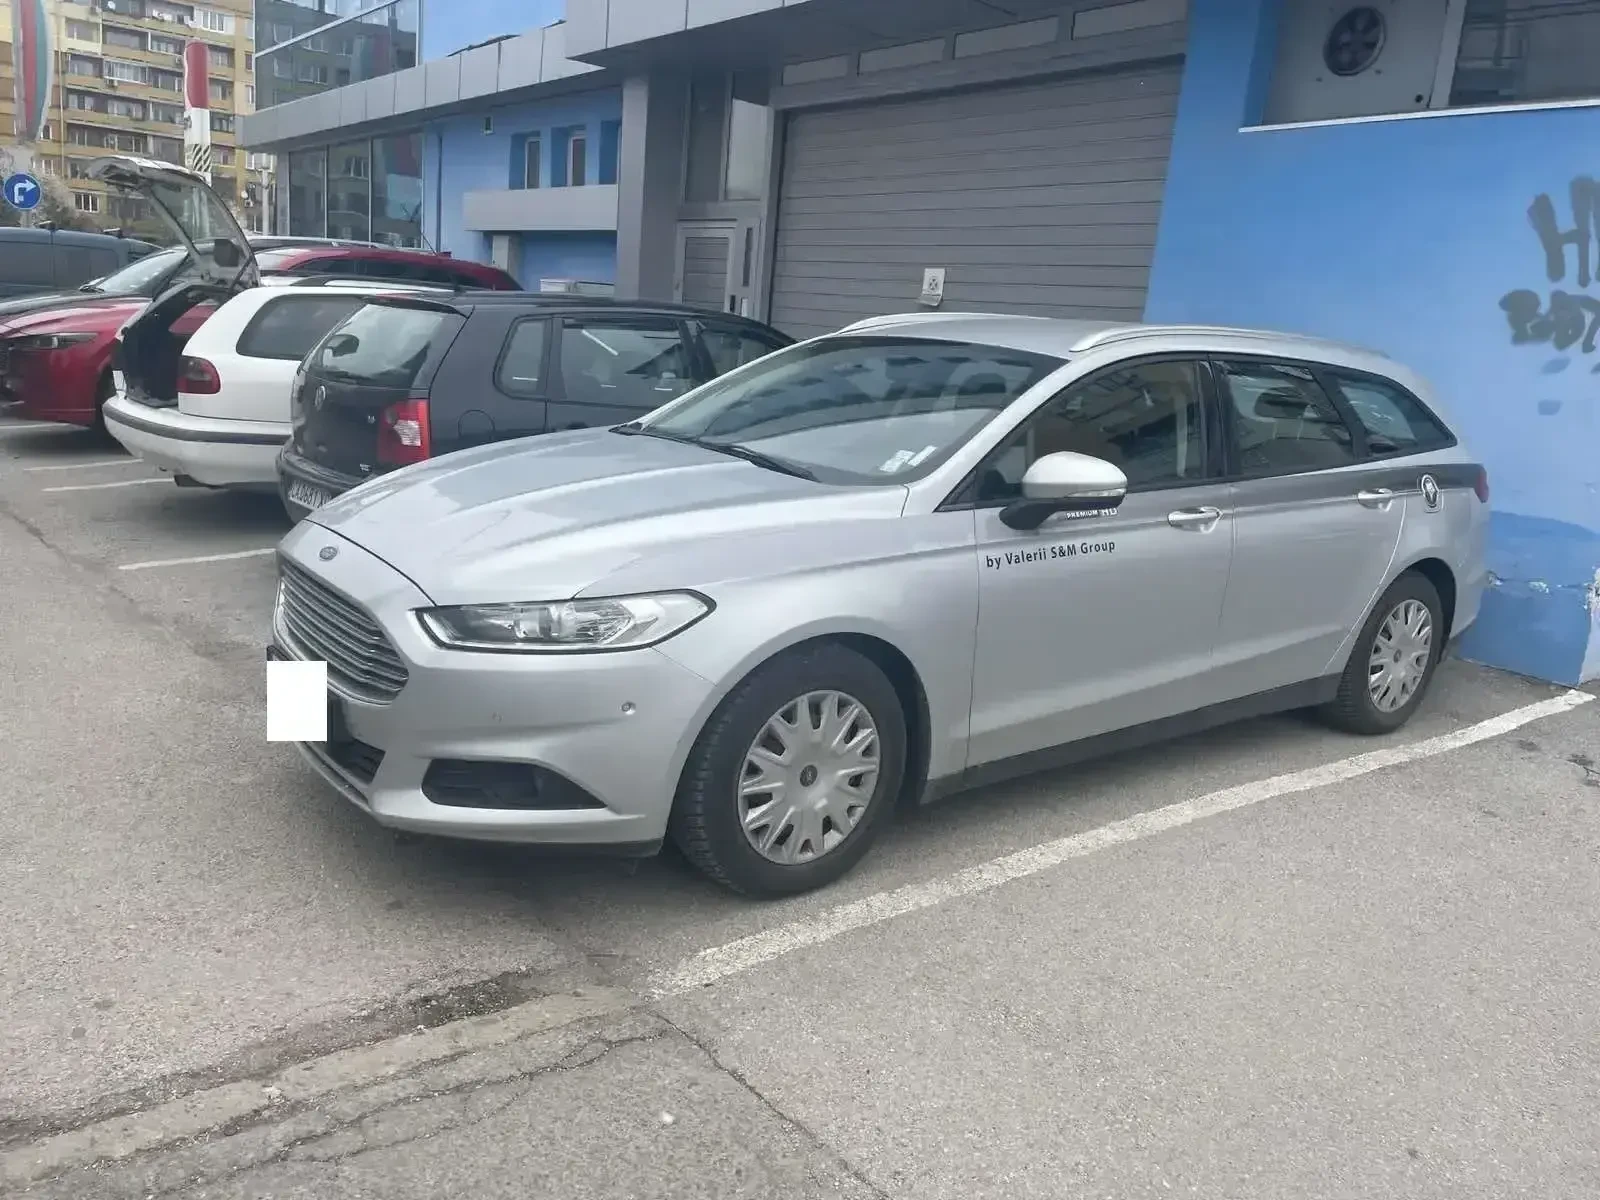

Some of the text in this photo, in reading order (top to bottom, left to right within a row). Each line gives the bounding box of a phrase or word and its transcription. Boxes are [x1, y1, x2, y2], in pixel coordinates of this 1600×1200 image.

[1066, 509, 1098, 519] PREMIUM
[986, 541, 1115, 570] by Valerii S&M Group
